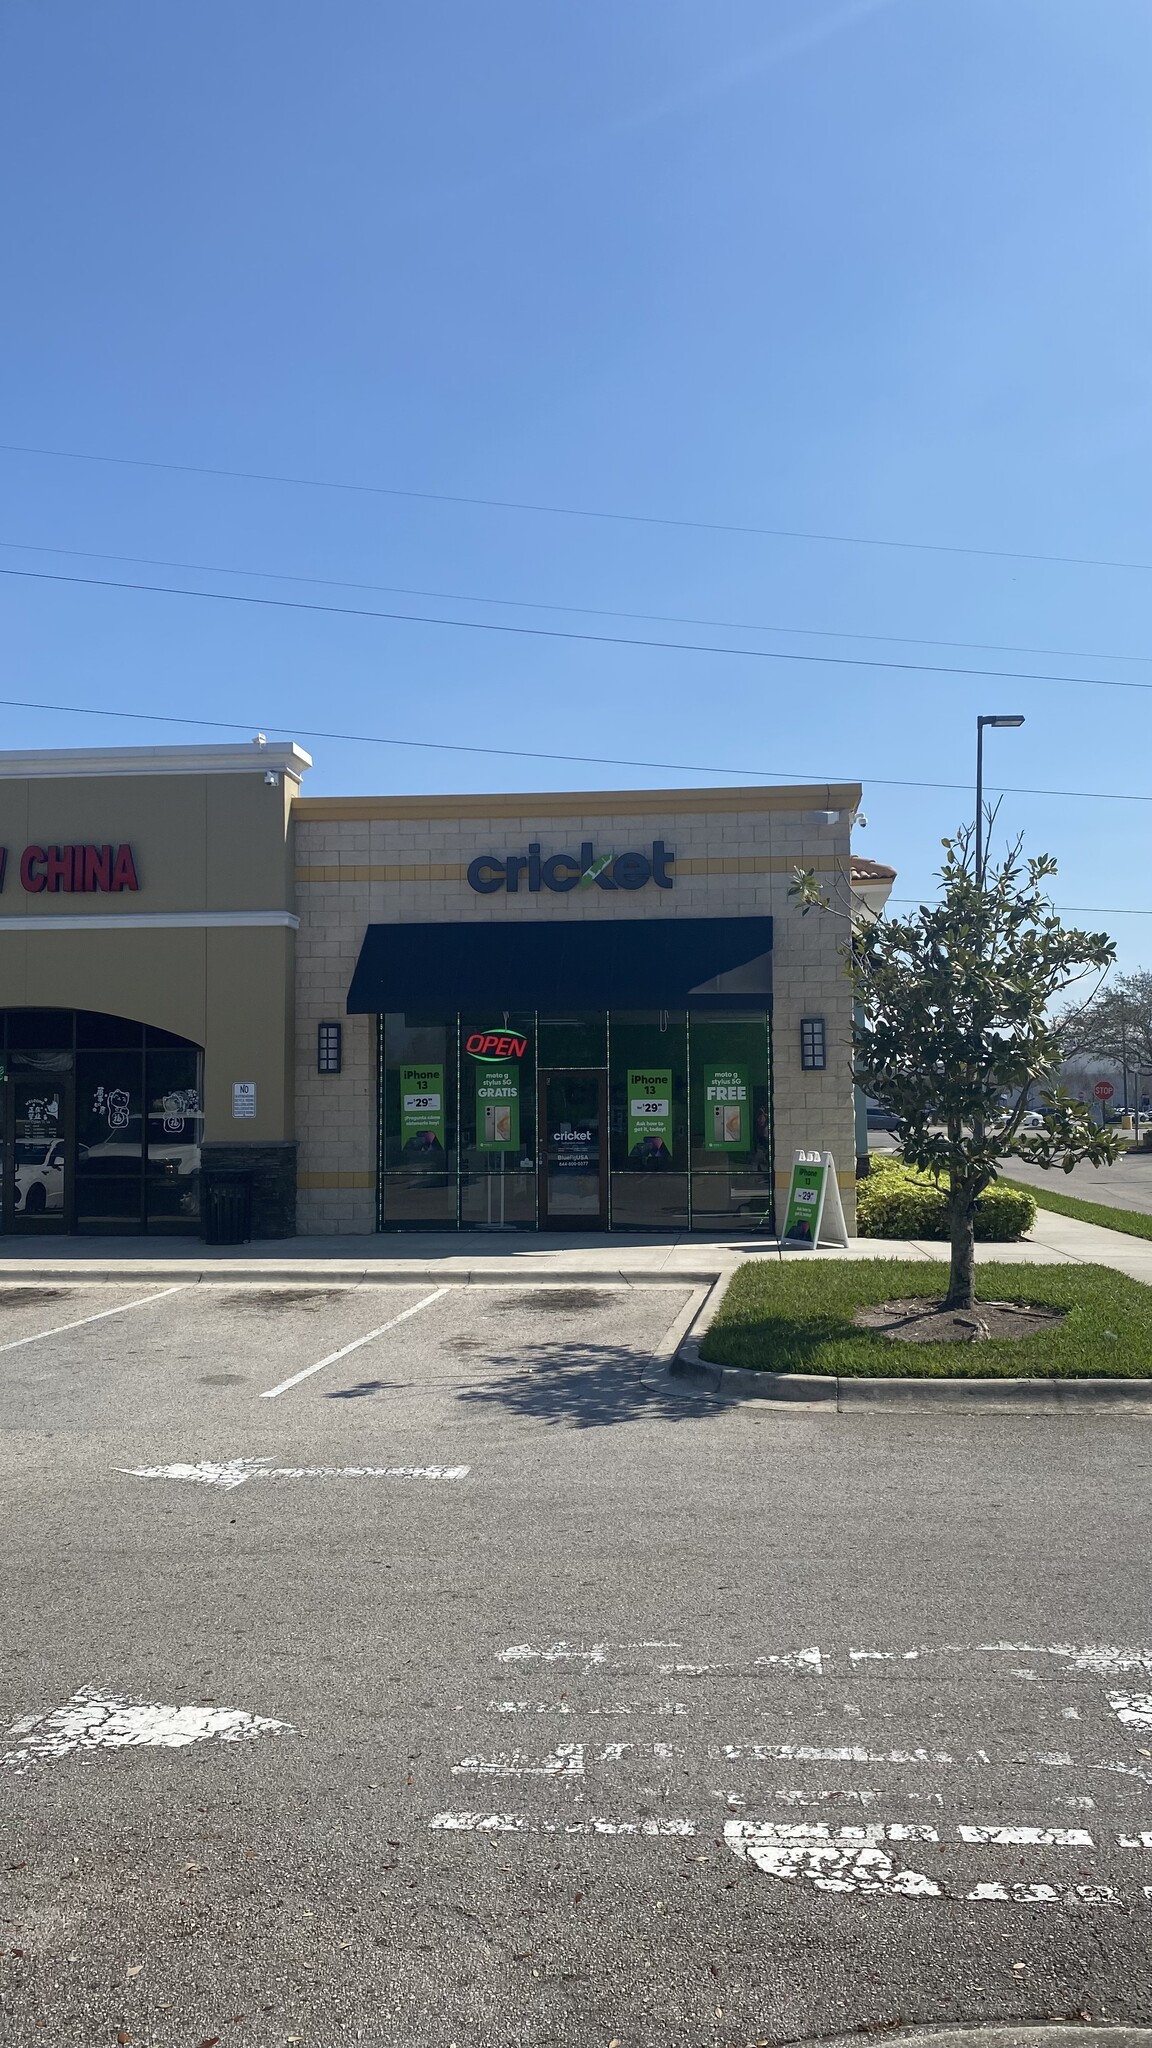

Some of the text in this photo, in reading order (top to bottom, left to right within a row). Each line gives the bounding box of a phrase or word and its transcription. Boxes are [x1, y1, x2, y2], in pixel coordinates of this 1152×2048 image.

[19, 844, 140, 894] CHINA
[467, 840, 674, 894] cricket
[466, 1034, 527, 1057] OPEN
[404, 1070, 440, 1080] iPhone
[631, 1075, 668, 1084] iPhone
[240, 1085, 249, 1094] NO
[417, 1081, 428, 1090] 13
[1095, 1086, 1113, 1094] STOP
[478, 1087, 518, 1098] GRATIS
[644, 1086, 656, 1095] 13
[706, 1086, 746, 1101] FREE
[553, 1131, 592, 1140] cricket
